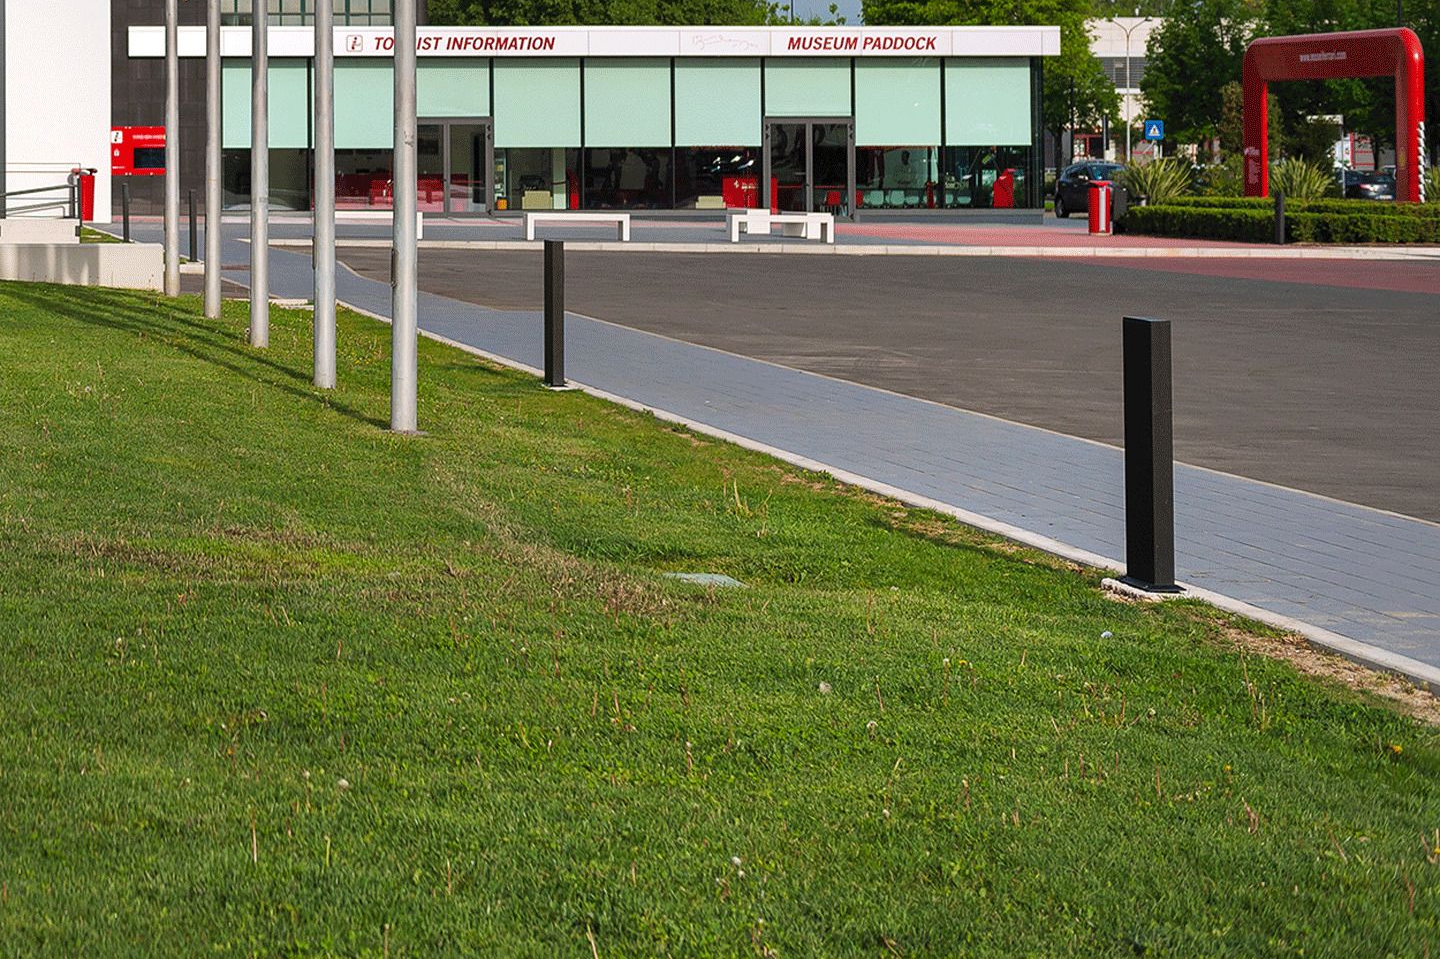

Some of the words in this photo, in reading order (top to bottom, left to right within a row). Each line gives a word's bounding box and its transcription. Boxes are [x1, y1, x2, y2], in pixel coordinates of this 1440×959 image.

[374, 36, 442, 51] TOIST
[446, 36, 556, 51] INFORMATION
[787, 36, 859, 51] MUSEUM
[862, 36, 937, 51] PADDOCK
